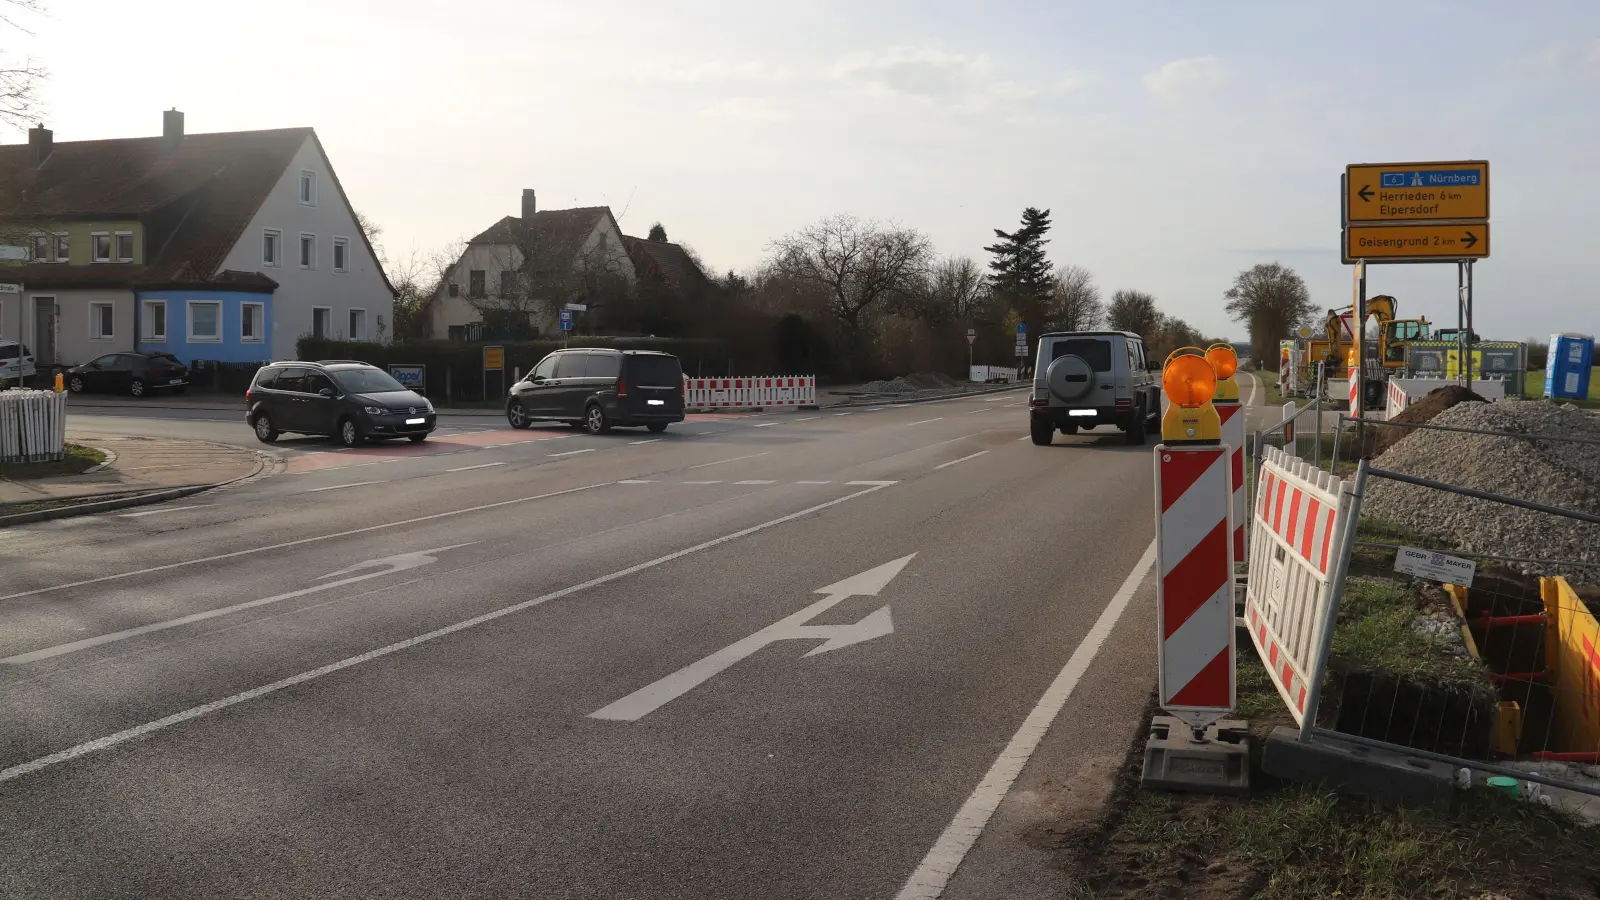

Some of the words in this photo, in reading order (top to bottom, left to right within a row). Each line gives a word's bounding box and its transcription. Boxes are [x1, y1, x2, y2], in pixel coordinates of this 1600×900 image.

[1391, 176, 1396, 184] 6
[1429, 173, 1477, 184] Nürnberg
[1380, 192, 1435, 202] Herrieden
[1440, 191, 1446, 200] 6
[1448, 192, 1462, 200] km
[1380, 204, 1440, 215] Elpersdorf
[1359, 236, 1429, 249] Geisengrund
[1433, 236, 1440, 246] 2
[1442, 237, 1456, 245] km
[1445, 559, 1472, 570] MAYER
